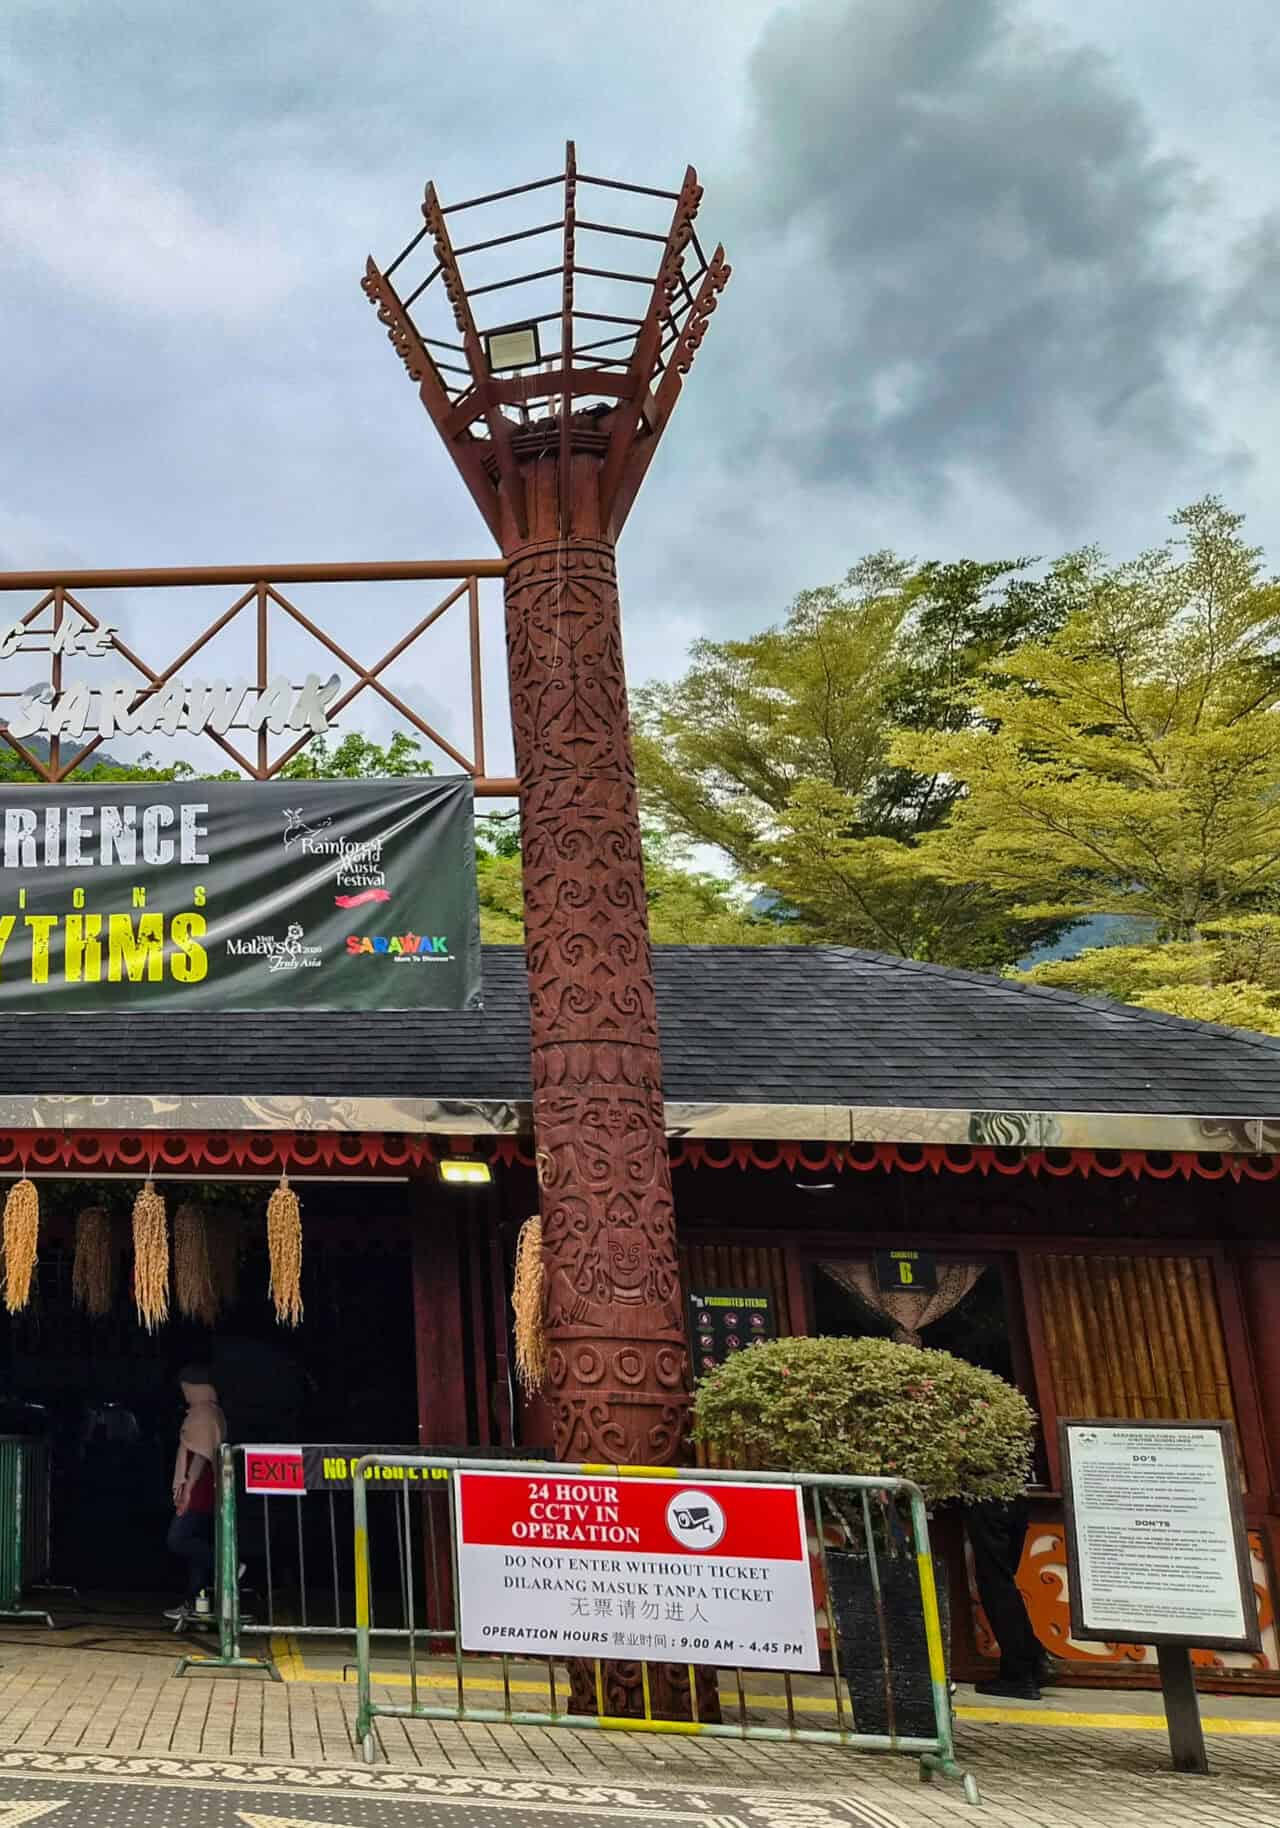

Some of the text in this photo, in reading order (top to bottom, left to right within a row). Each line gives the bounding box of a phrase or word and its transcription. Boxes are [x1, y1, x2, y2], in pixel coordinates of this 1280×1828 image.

[50, 618, 119, 658] KE
[7, 672, 343, 740] SARAWAK
[301, 836, 383, 855] Rainforest
[339, 849, 381, 863] World
[339, 862, 382, 873] Music
[336, 871, 385, 887] Festival
[346, 935, 449, 956] SARAWAK
[267, 955, 300, 973] Truly
[251, 1461, 302, 1481] EXIT
[323, 1458, 347, 1480] NO
[528, 1484, 618, 1503] 24 HOUR
[529, 1505, 619, 1522] CCTV IN
[511, 1525, 640, 1544] OPERATION
[504, 1555, 770, 1581] DO NOT ENTER WITHOUT TICKET
[503, 1576, 775, 1603] DILARANG MASUK TANPA TICKET
[482, 1626, 559, 1640] OPERATION
[562, 1630, 609, 1643] HOURS
[612, 1632, 667, 1649] 营业时间
[680, 1637, 711, 1650] 9.00
[714, 1639, 734, 1651] AM
[749, 1641, 779, 1654] 4.45
[784, 1643, 804, 1656] PM
